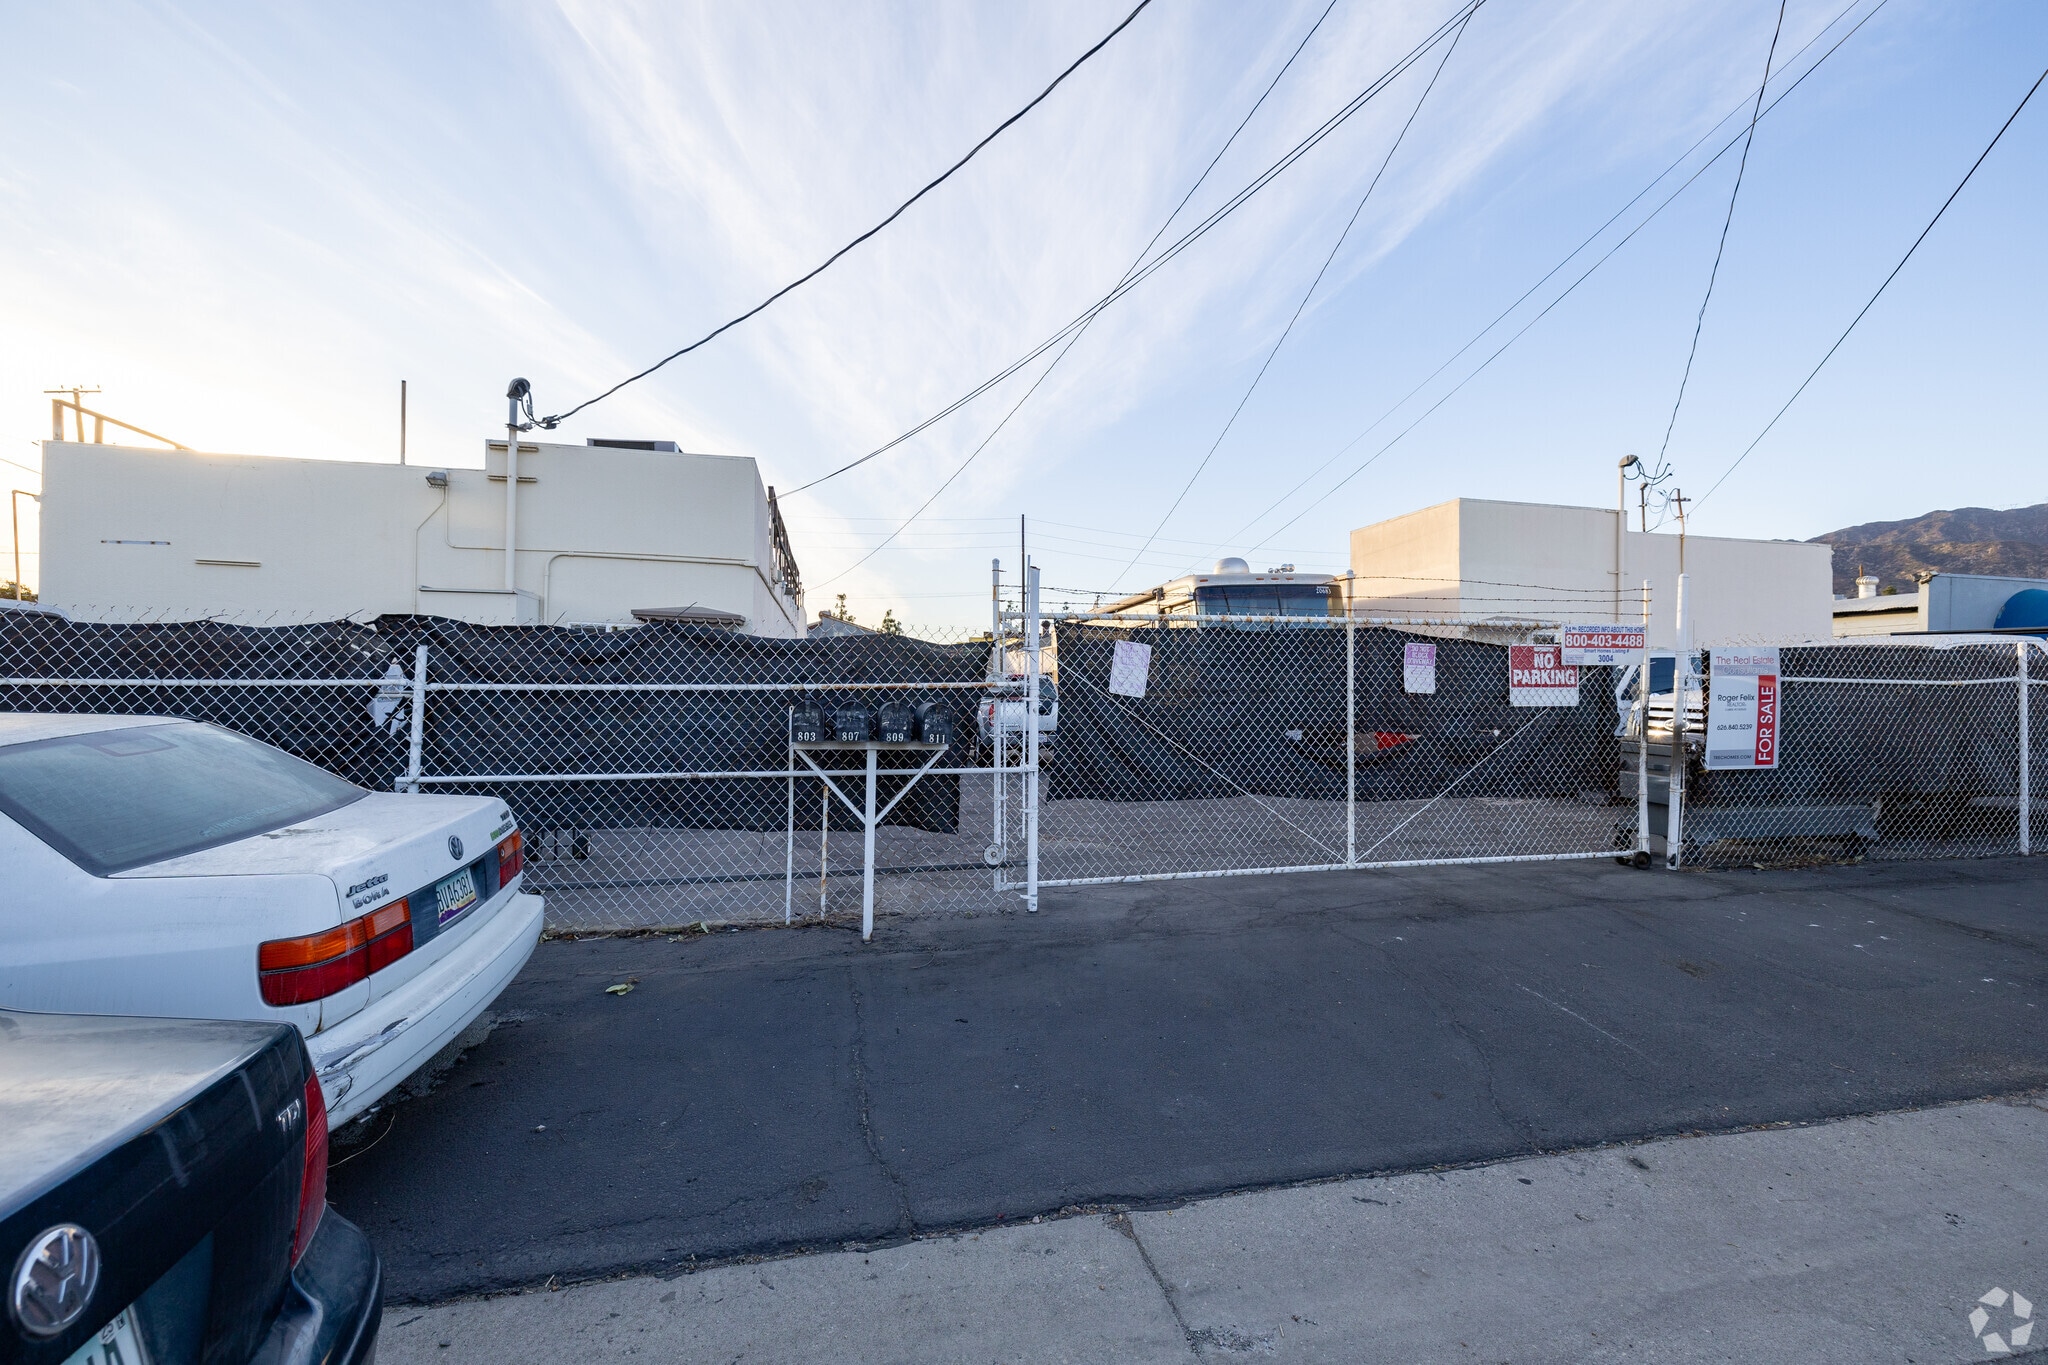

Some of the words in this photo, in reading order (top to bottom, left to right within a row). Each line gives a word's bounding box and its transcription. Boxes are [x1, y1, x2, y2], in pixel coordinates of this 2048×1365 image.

[1565, 634, 1643, 647] 800-403-4488
[1534, 653, 1554, 669] NO
[1598, 655, 1613, 663] 3004
[1716, 656, 1731, 665] The
[1733, 656, 1750, 665] Real
[1752, 655, 1775, 665] Estate
[1513, 669, 1576, 685] PARKING
[1717, 694, 1738, 703] Roger
[1760, 687, 1774, 724] SALE
[1717, 723, 1753, 731] 626.840.5239
[797, 731, 816, 741] 803
[841, 731, 859, 742] 807
[886, 732, 904, 742] 809
[928, 733, 945, 744] 811
[1758, 728, 1773, 761] FOR
[346, 873, 388, 898] Jetta
[352, 886, 390, 909] BORA
[436, 873, 473, 912] BVA6381
